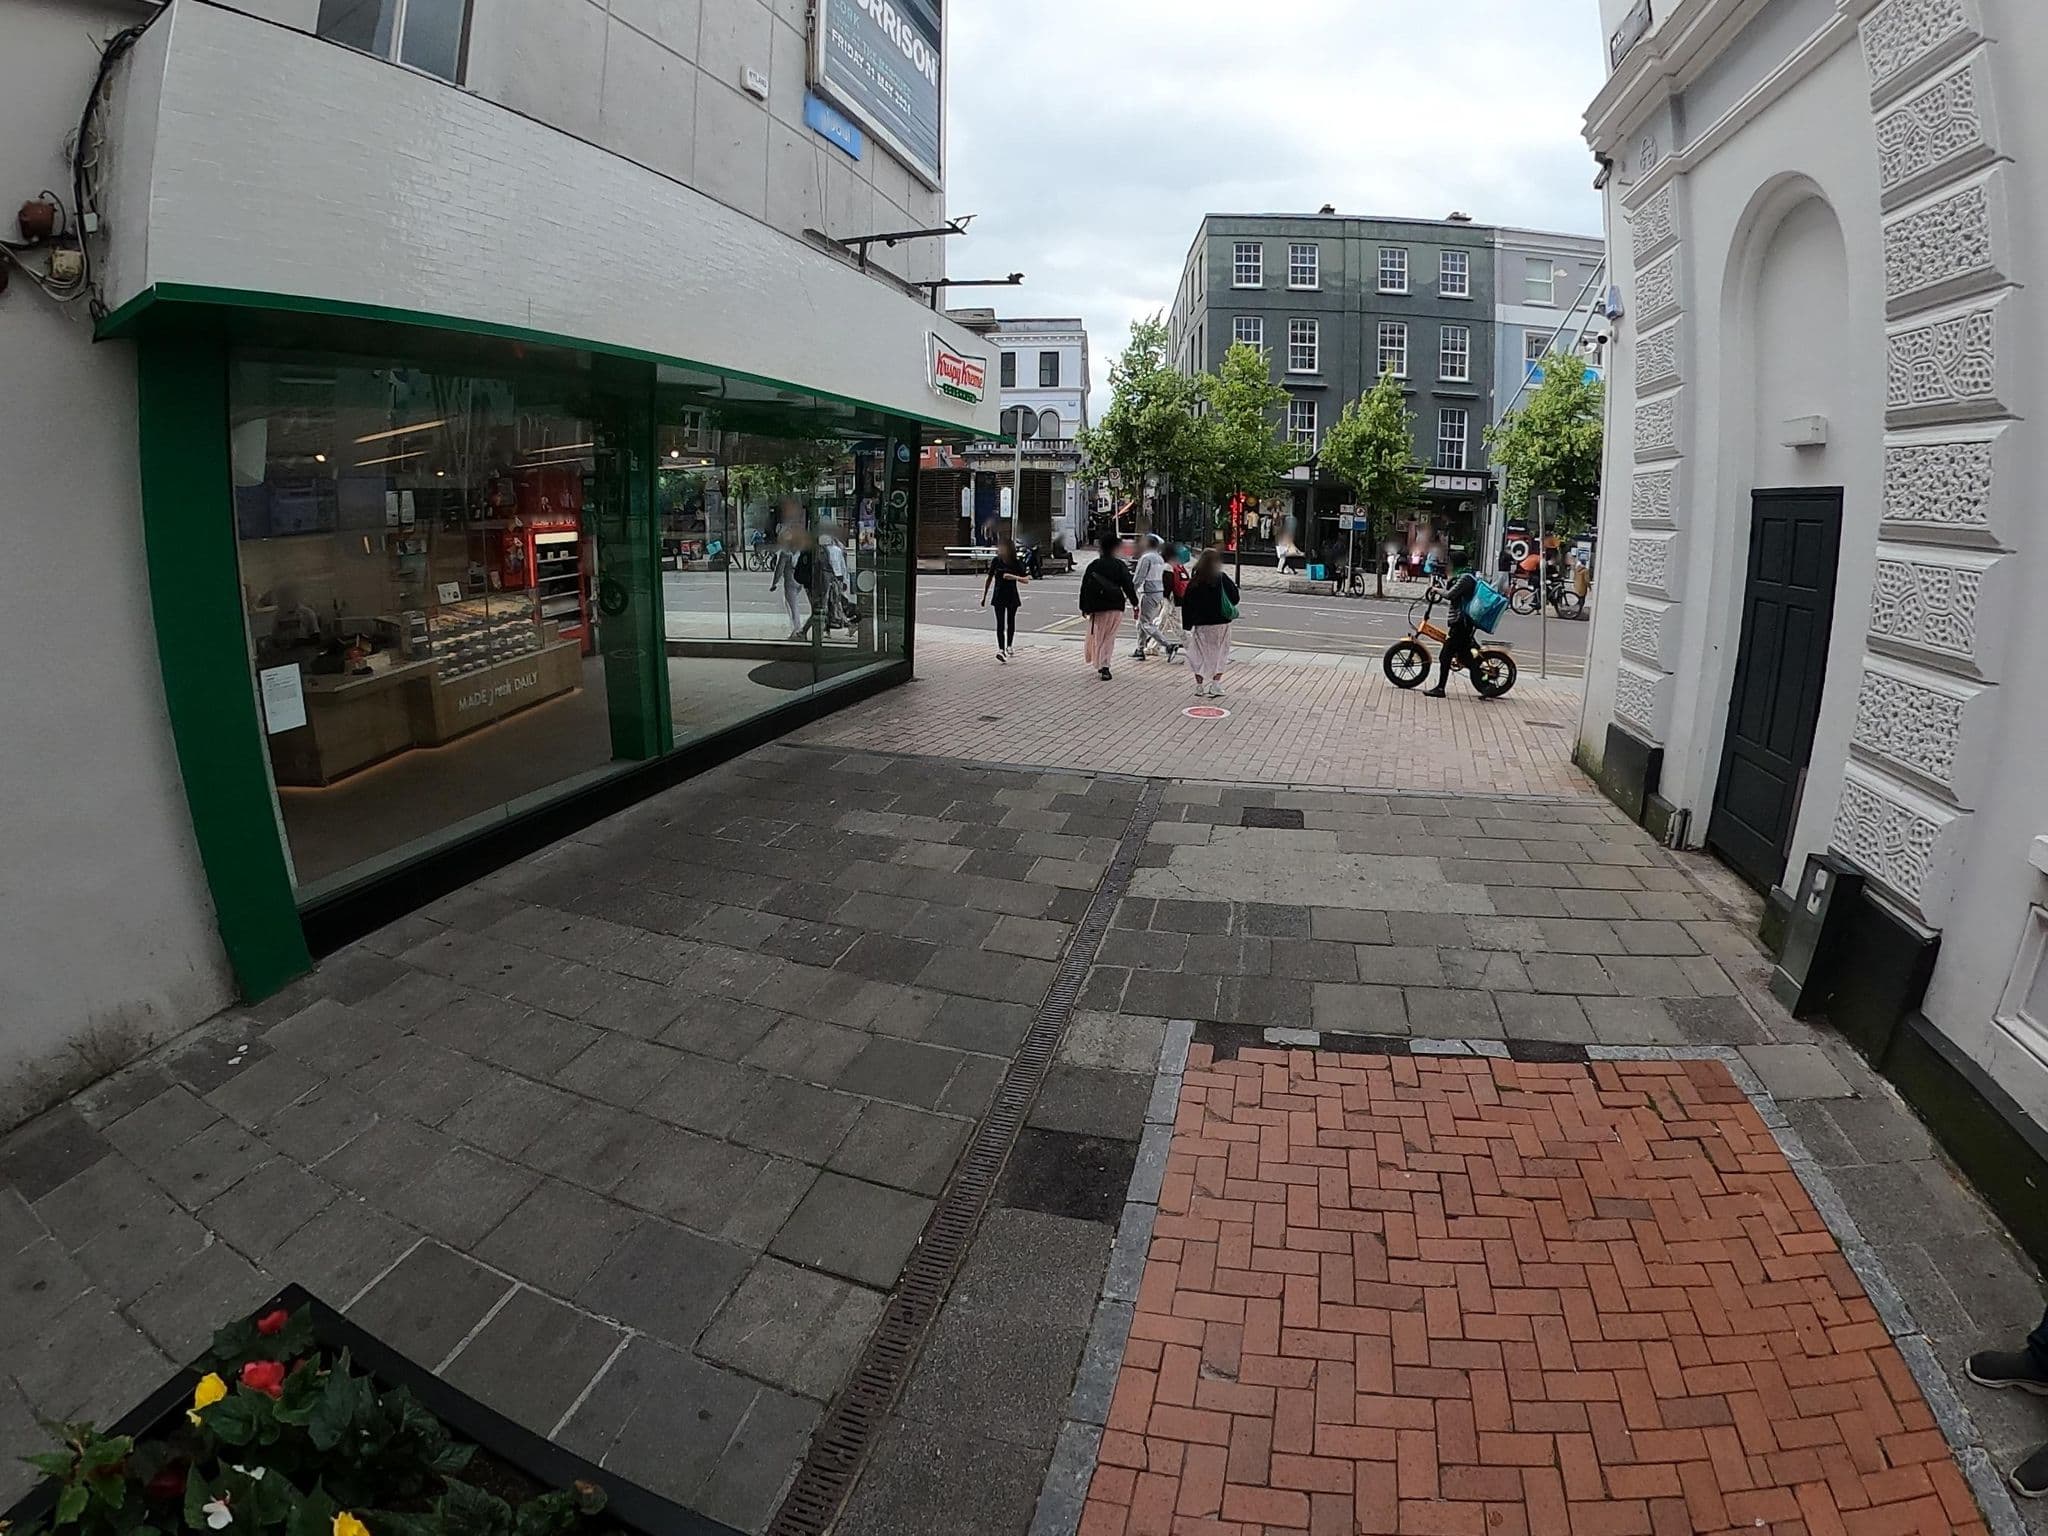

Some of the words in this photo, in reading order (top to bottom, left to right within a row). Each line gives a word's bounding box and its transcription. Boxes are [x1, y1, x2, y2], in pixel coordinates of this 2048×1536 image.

[832, 28, 864, 69] FRIDAY
[458, 688, 487, 711] MADE
[514, 671, 537, 691] DAILY
